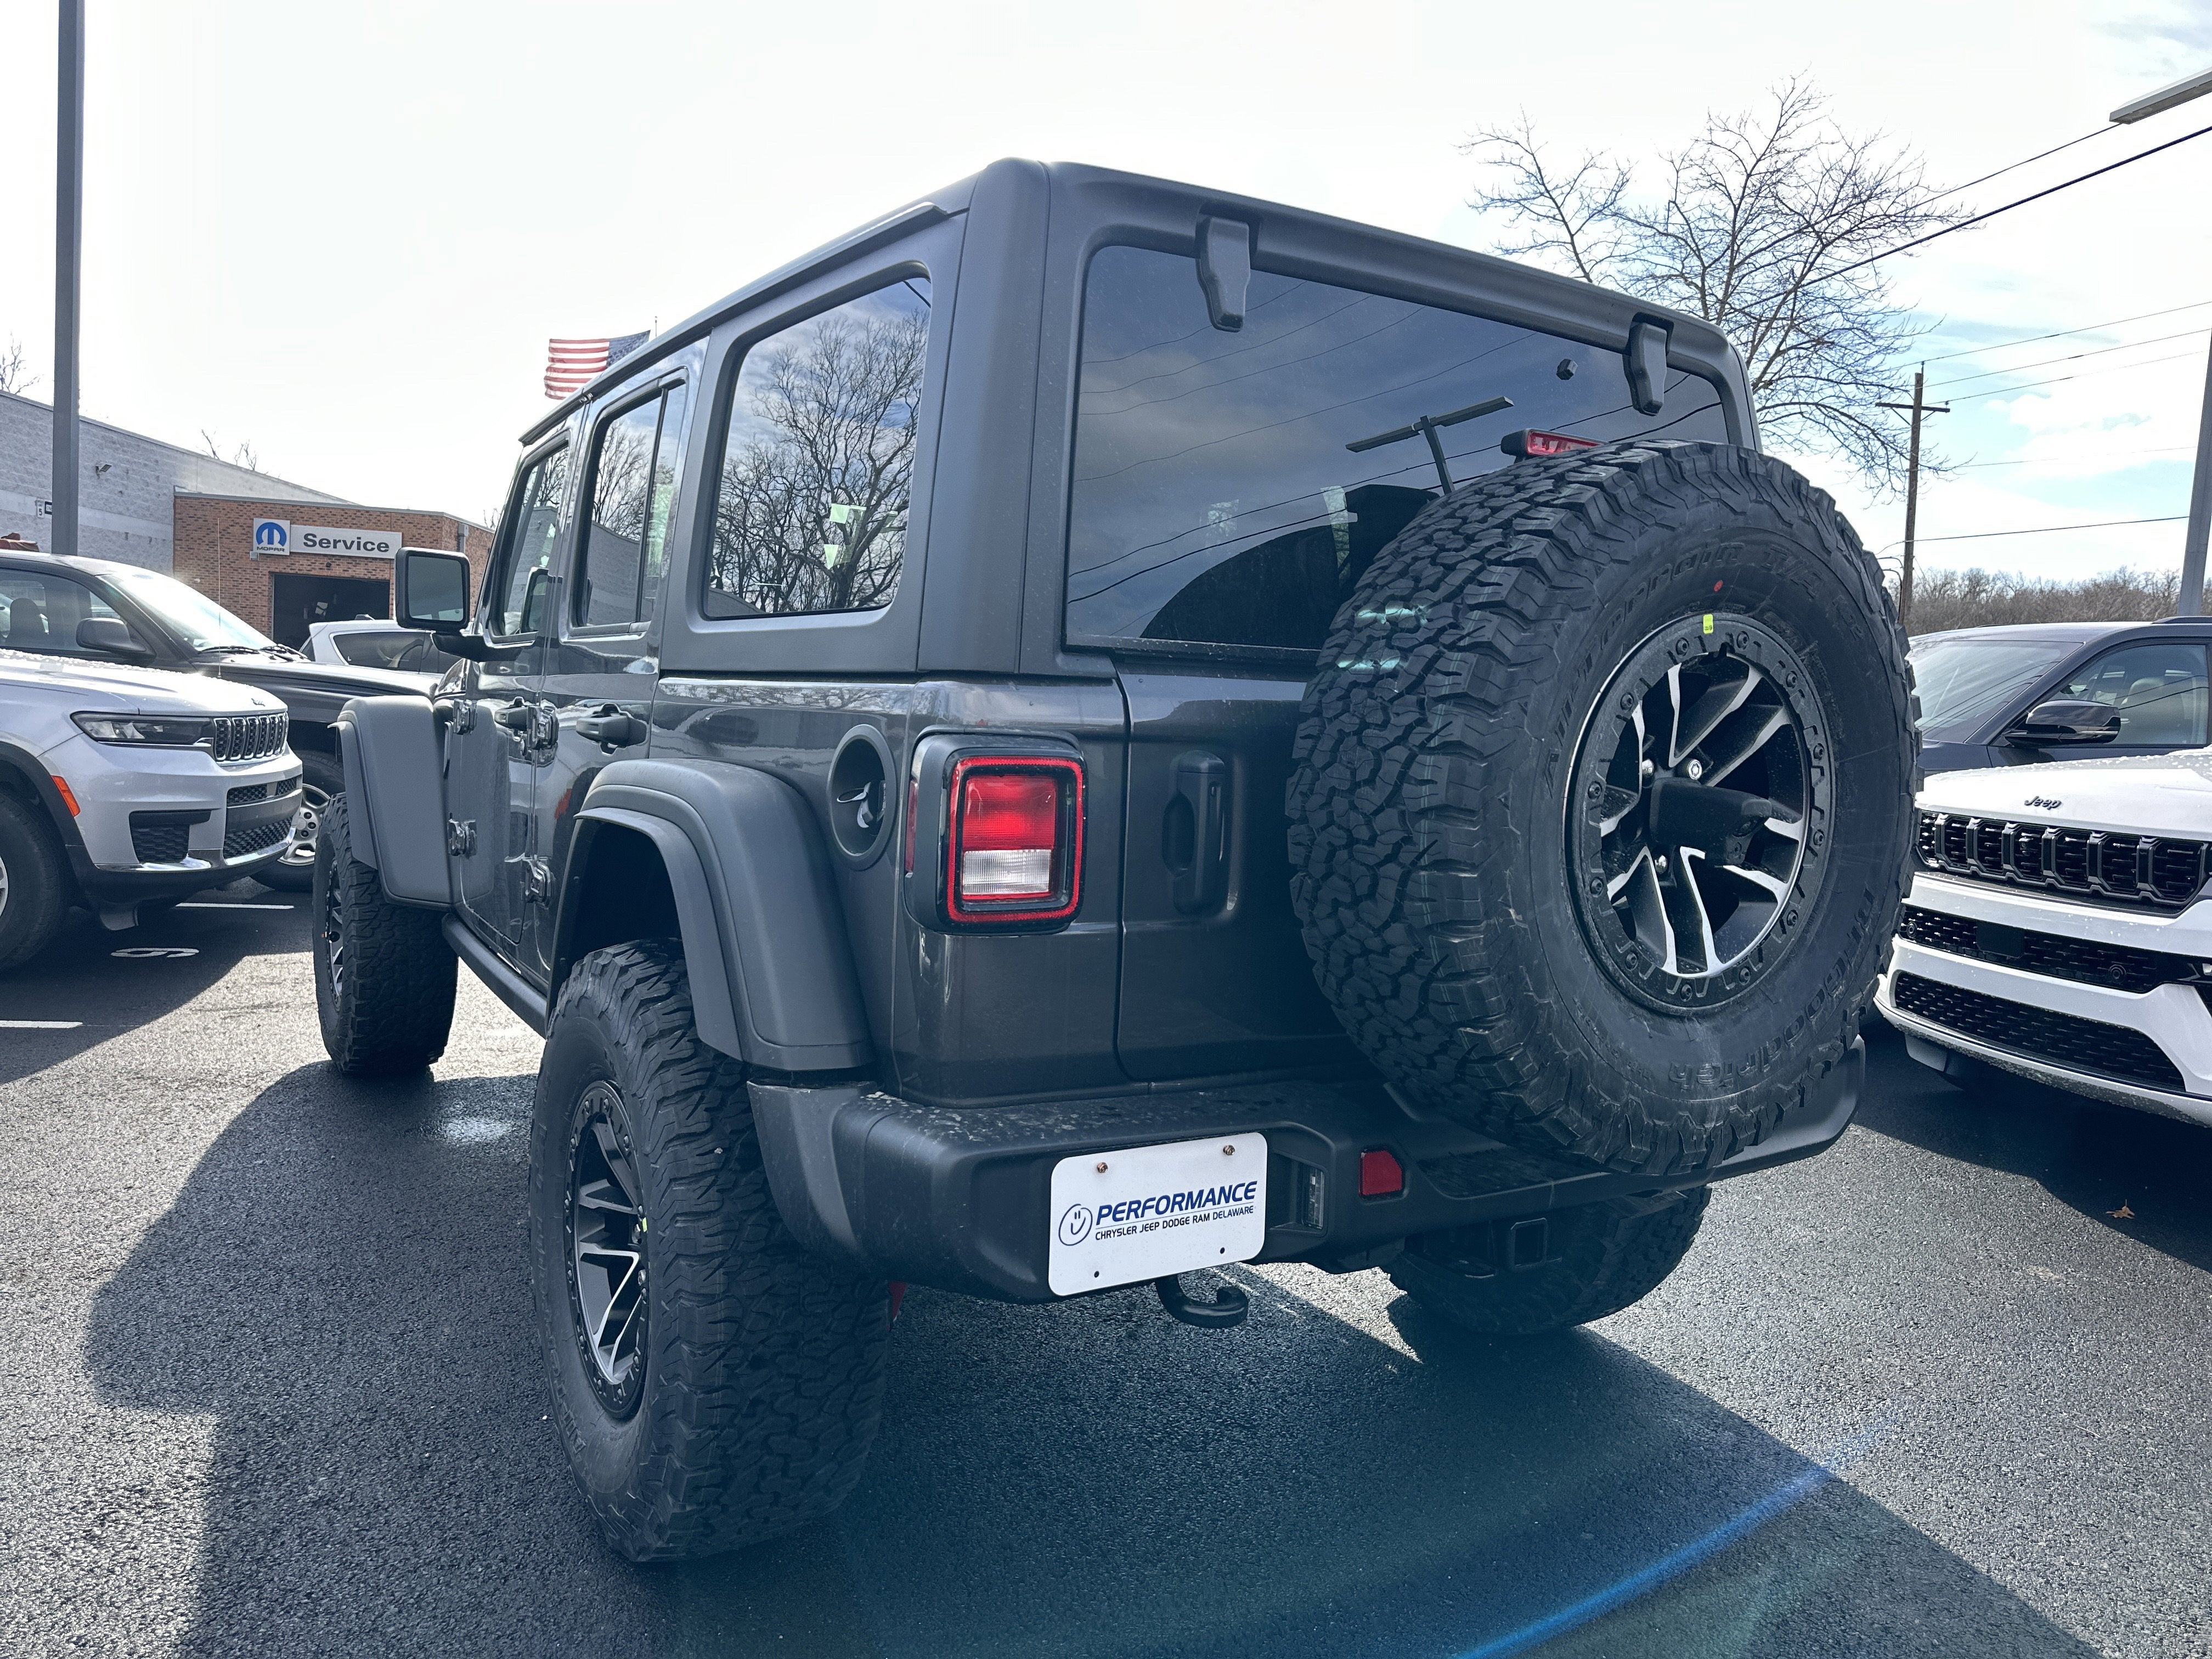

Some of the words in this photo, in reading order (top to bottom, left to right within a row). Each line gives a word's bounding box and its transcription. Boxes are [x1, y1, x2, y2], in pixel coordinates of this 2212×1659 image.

[303, 533, 390, 553] Service
[2024, 795, 2062, 810] Jeep
[1096, 1180, 1258, 1226] PERFORMANCE
[1095, 1224, 1137, 1240] CHRYSLER
[1139, 1221, 1160, 1233] JEEP
[1162, 1216, 1190, 1229] DODGE
[1192, 1212, 1210, 1224] RAM
[1212, 1205, 1254, 1220] DELAWARE
